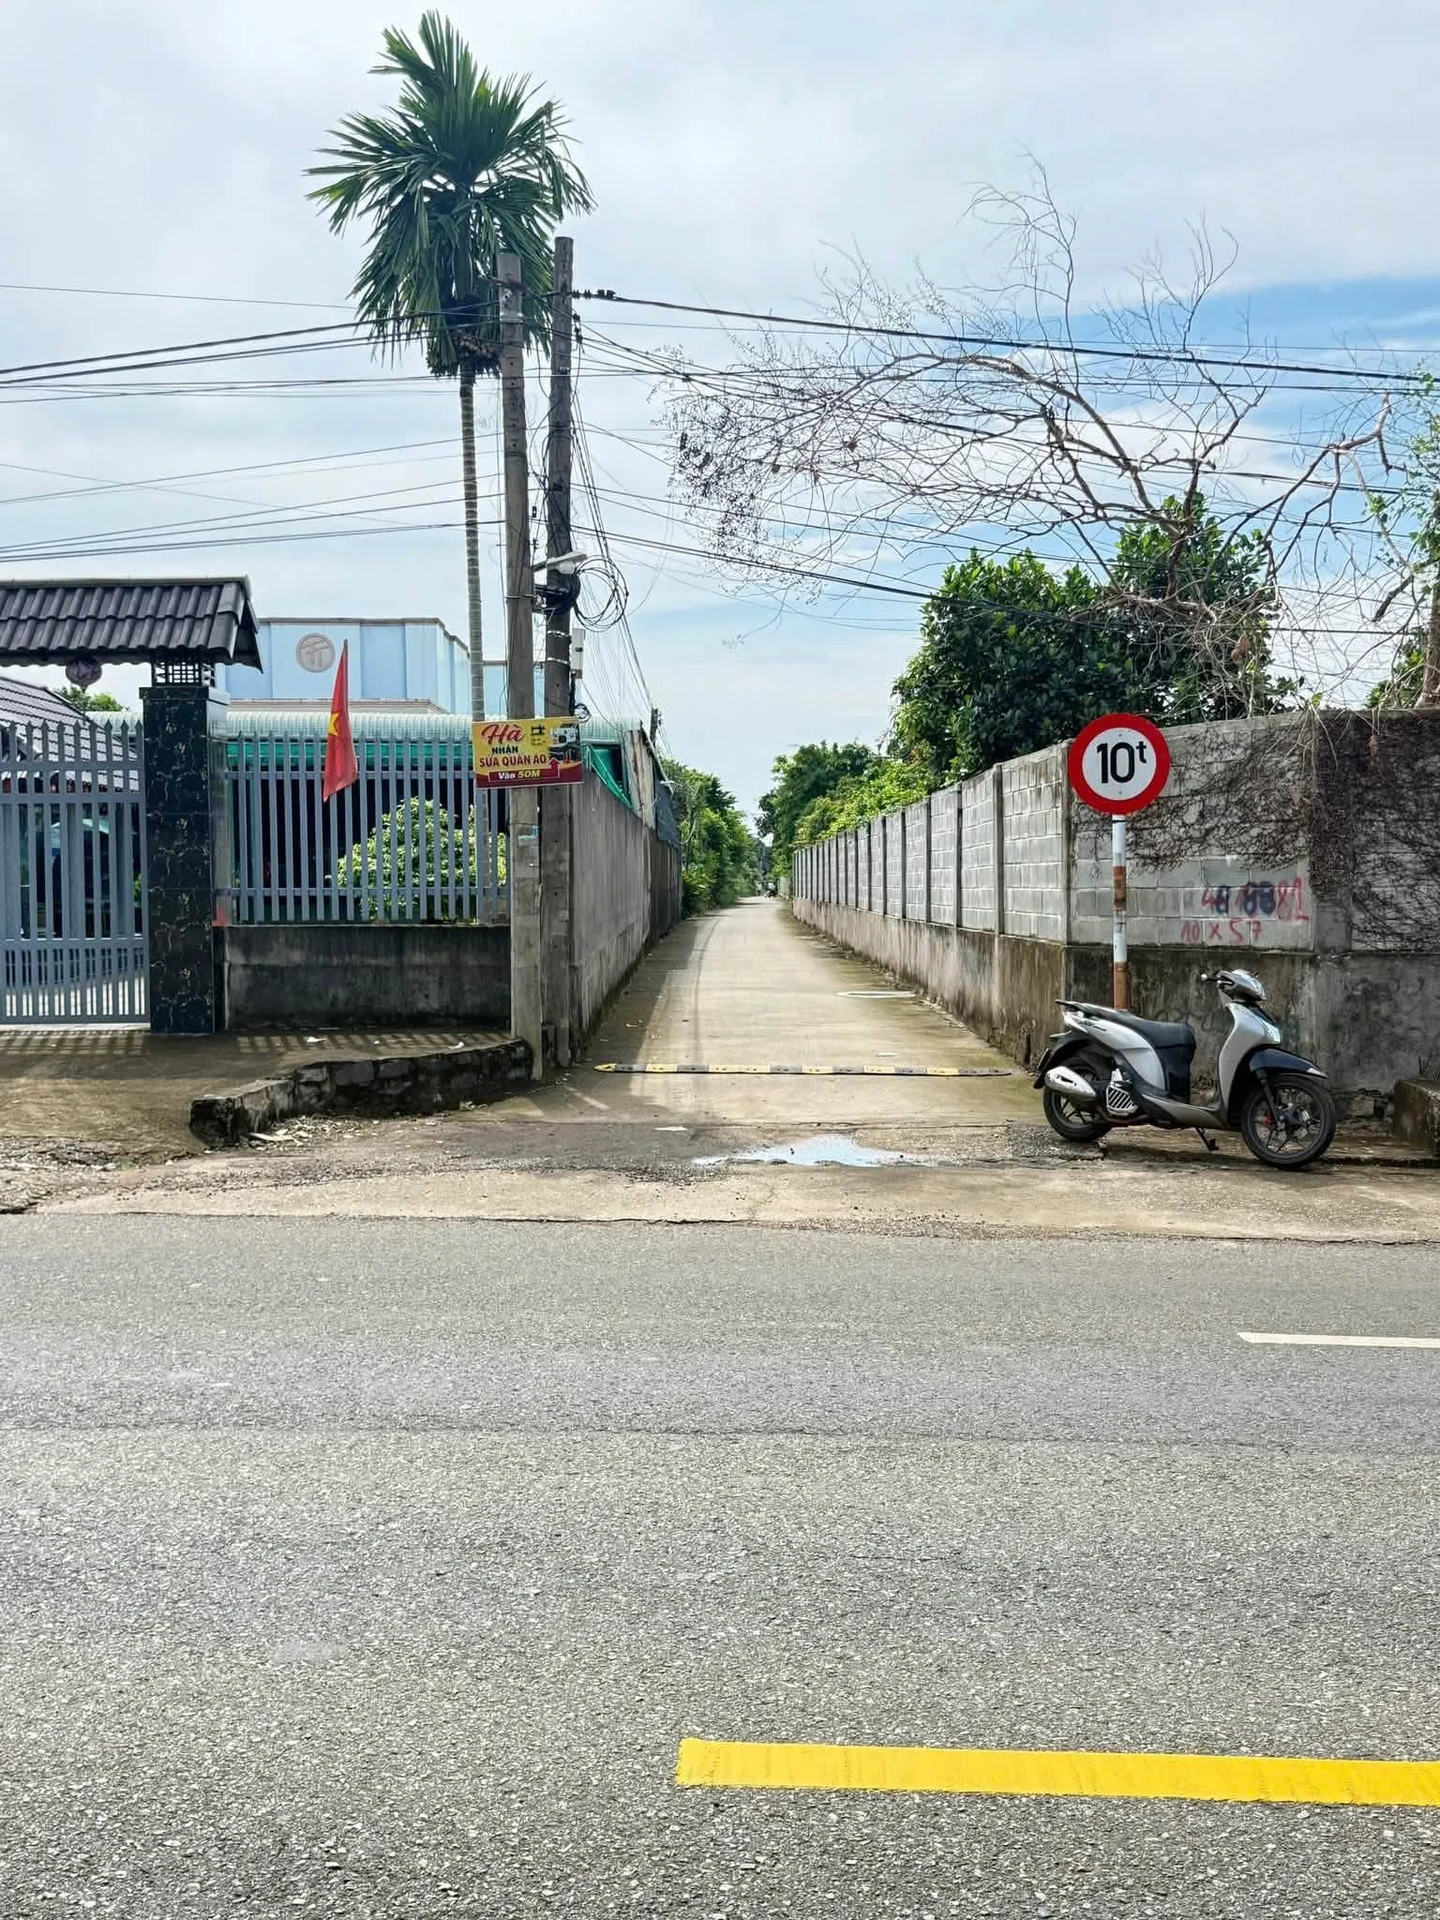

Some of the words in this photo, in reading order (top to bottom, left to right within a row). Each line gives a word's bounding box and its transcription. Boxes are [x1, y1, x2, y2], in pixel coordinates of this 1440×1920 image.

[481, 724, 526, 745] Hà
[498, 771, 516, 780] Vào
[518, 769, 541, 779] 50M
